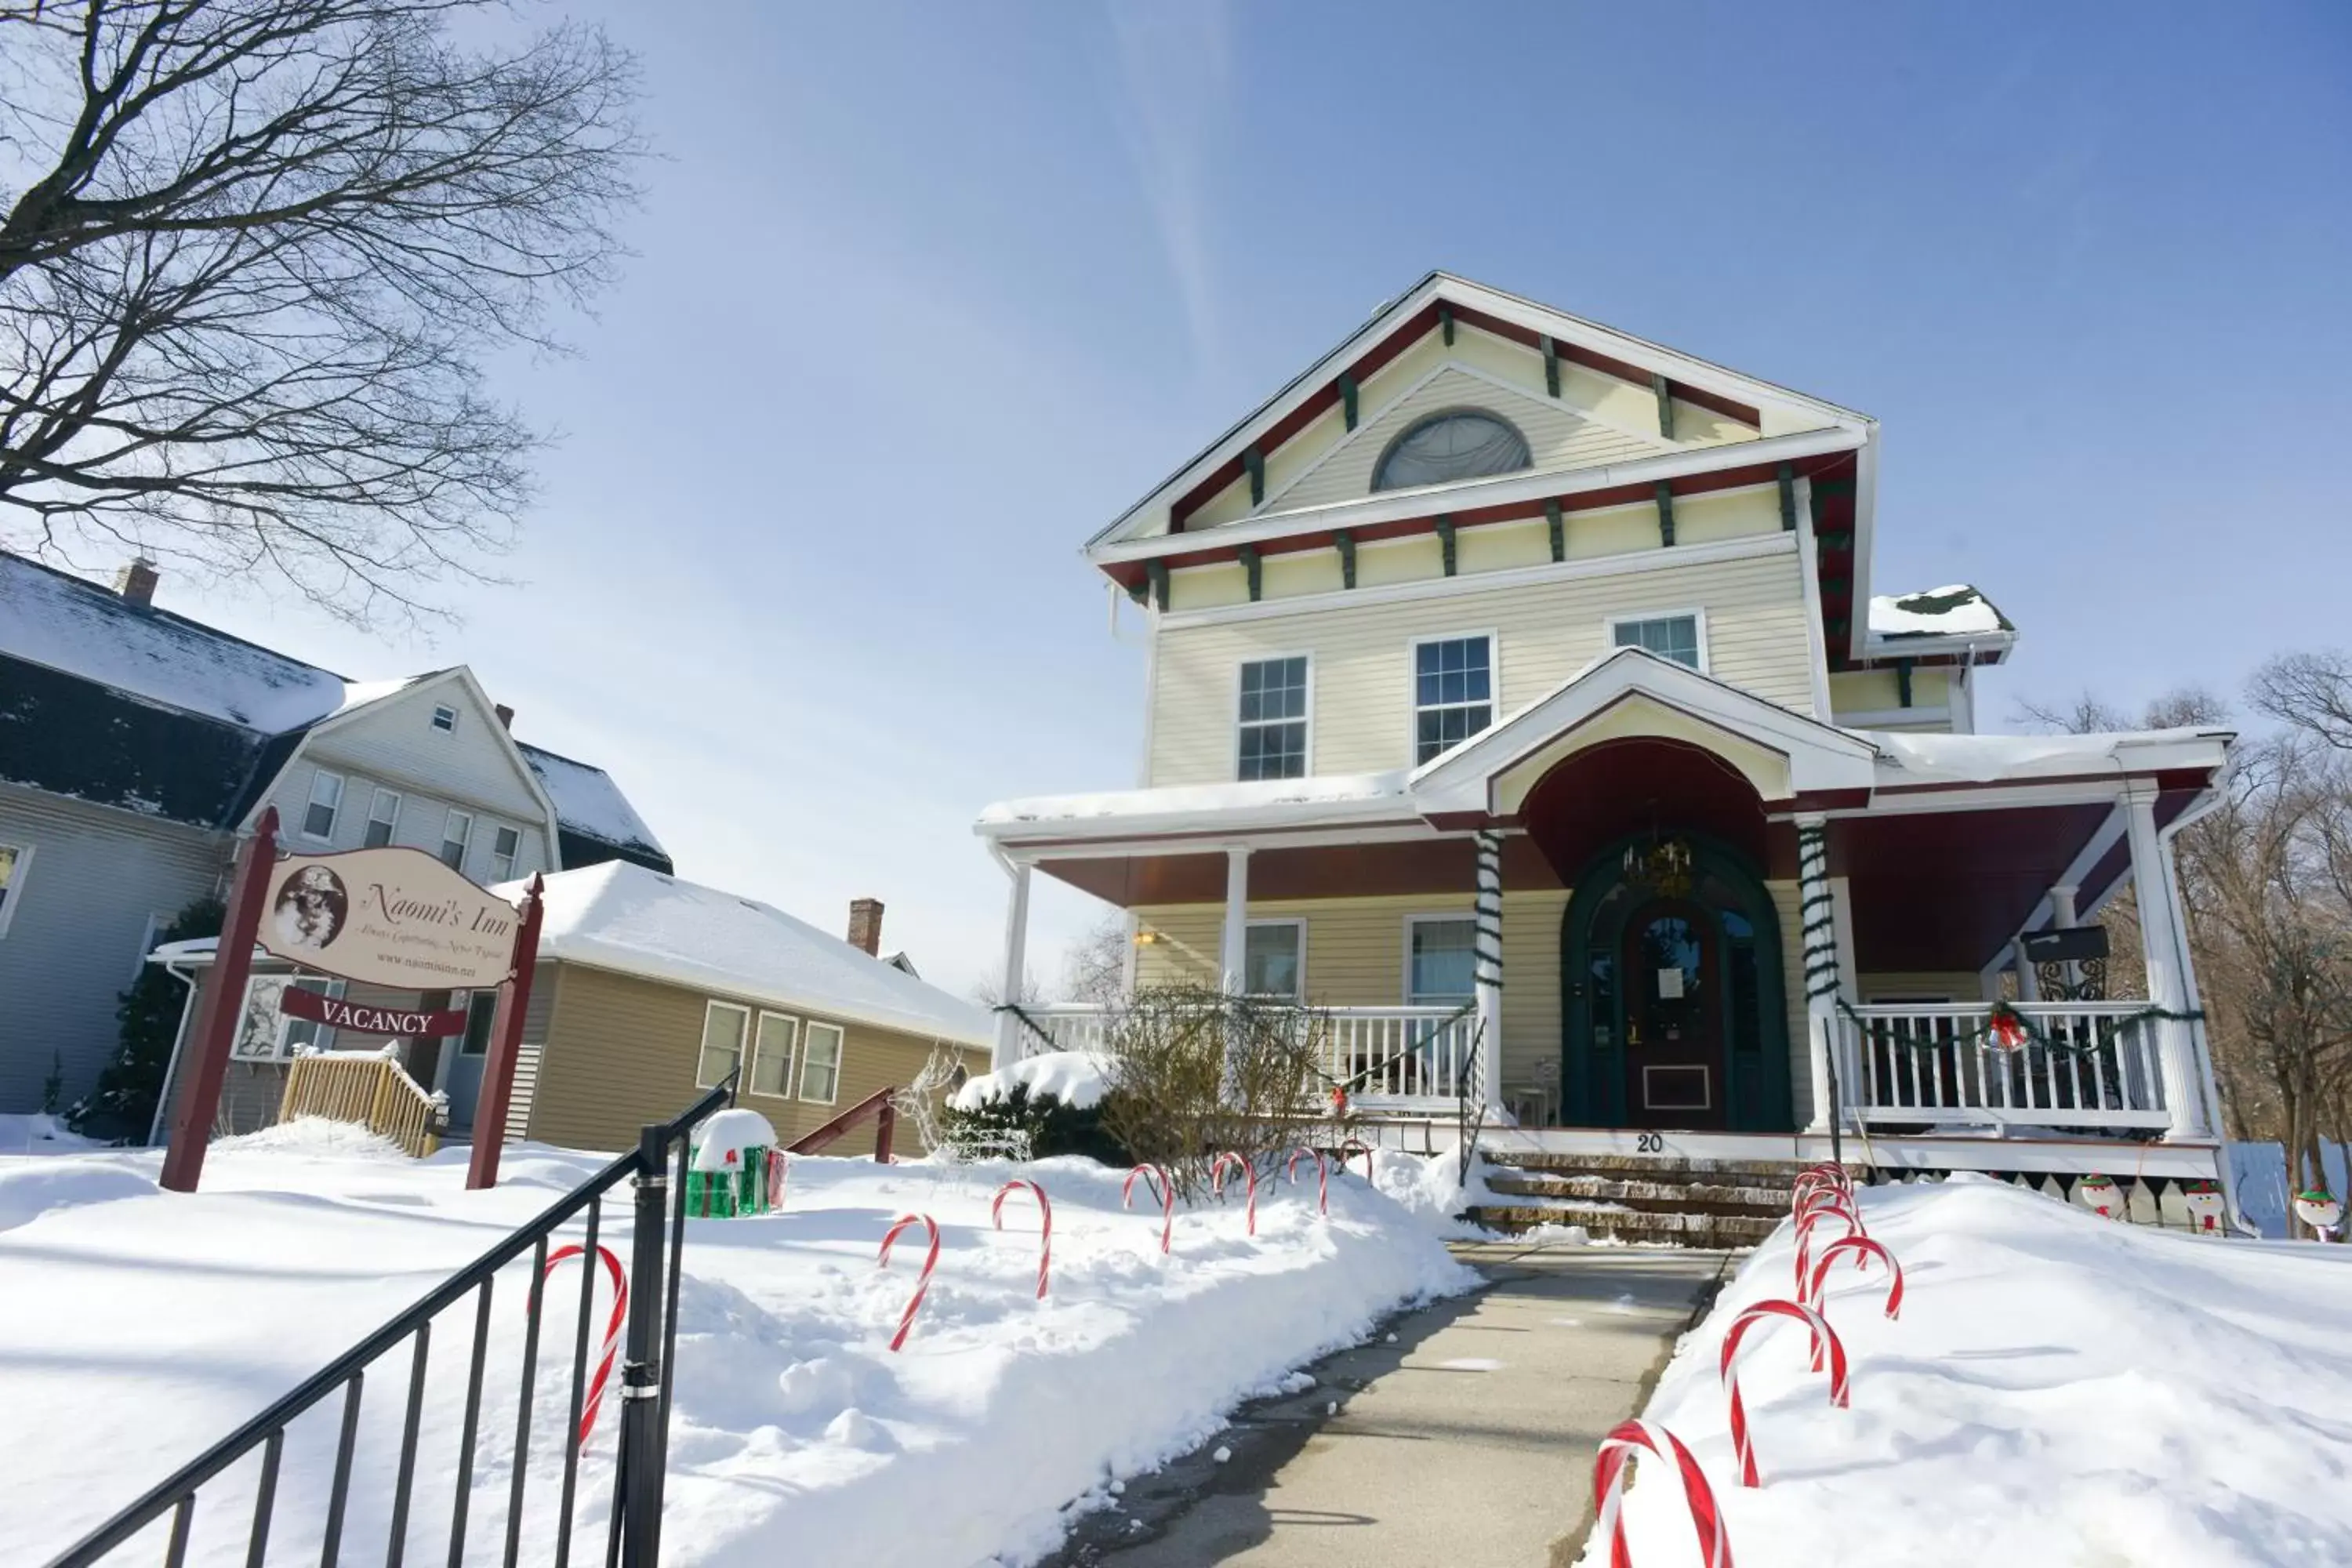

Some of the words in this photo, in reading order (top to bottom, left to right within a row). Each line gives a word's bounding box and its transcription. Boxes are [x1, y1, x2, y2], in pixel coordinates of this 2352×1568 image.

[360, 883, 463, 926] Naomi's
[470, 906, 509, 937] Inn
[322, 1000, 433, 1033] VACANCY
[1637, 1134, 1663, 1152] 20
